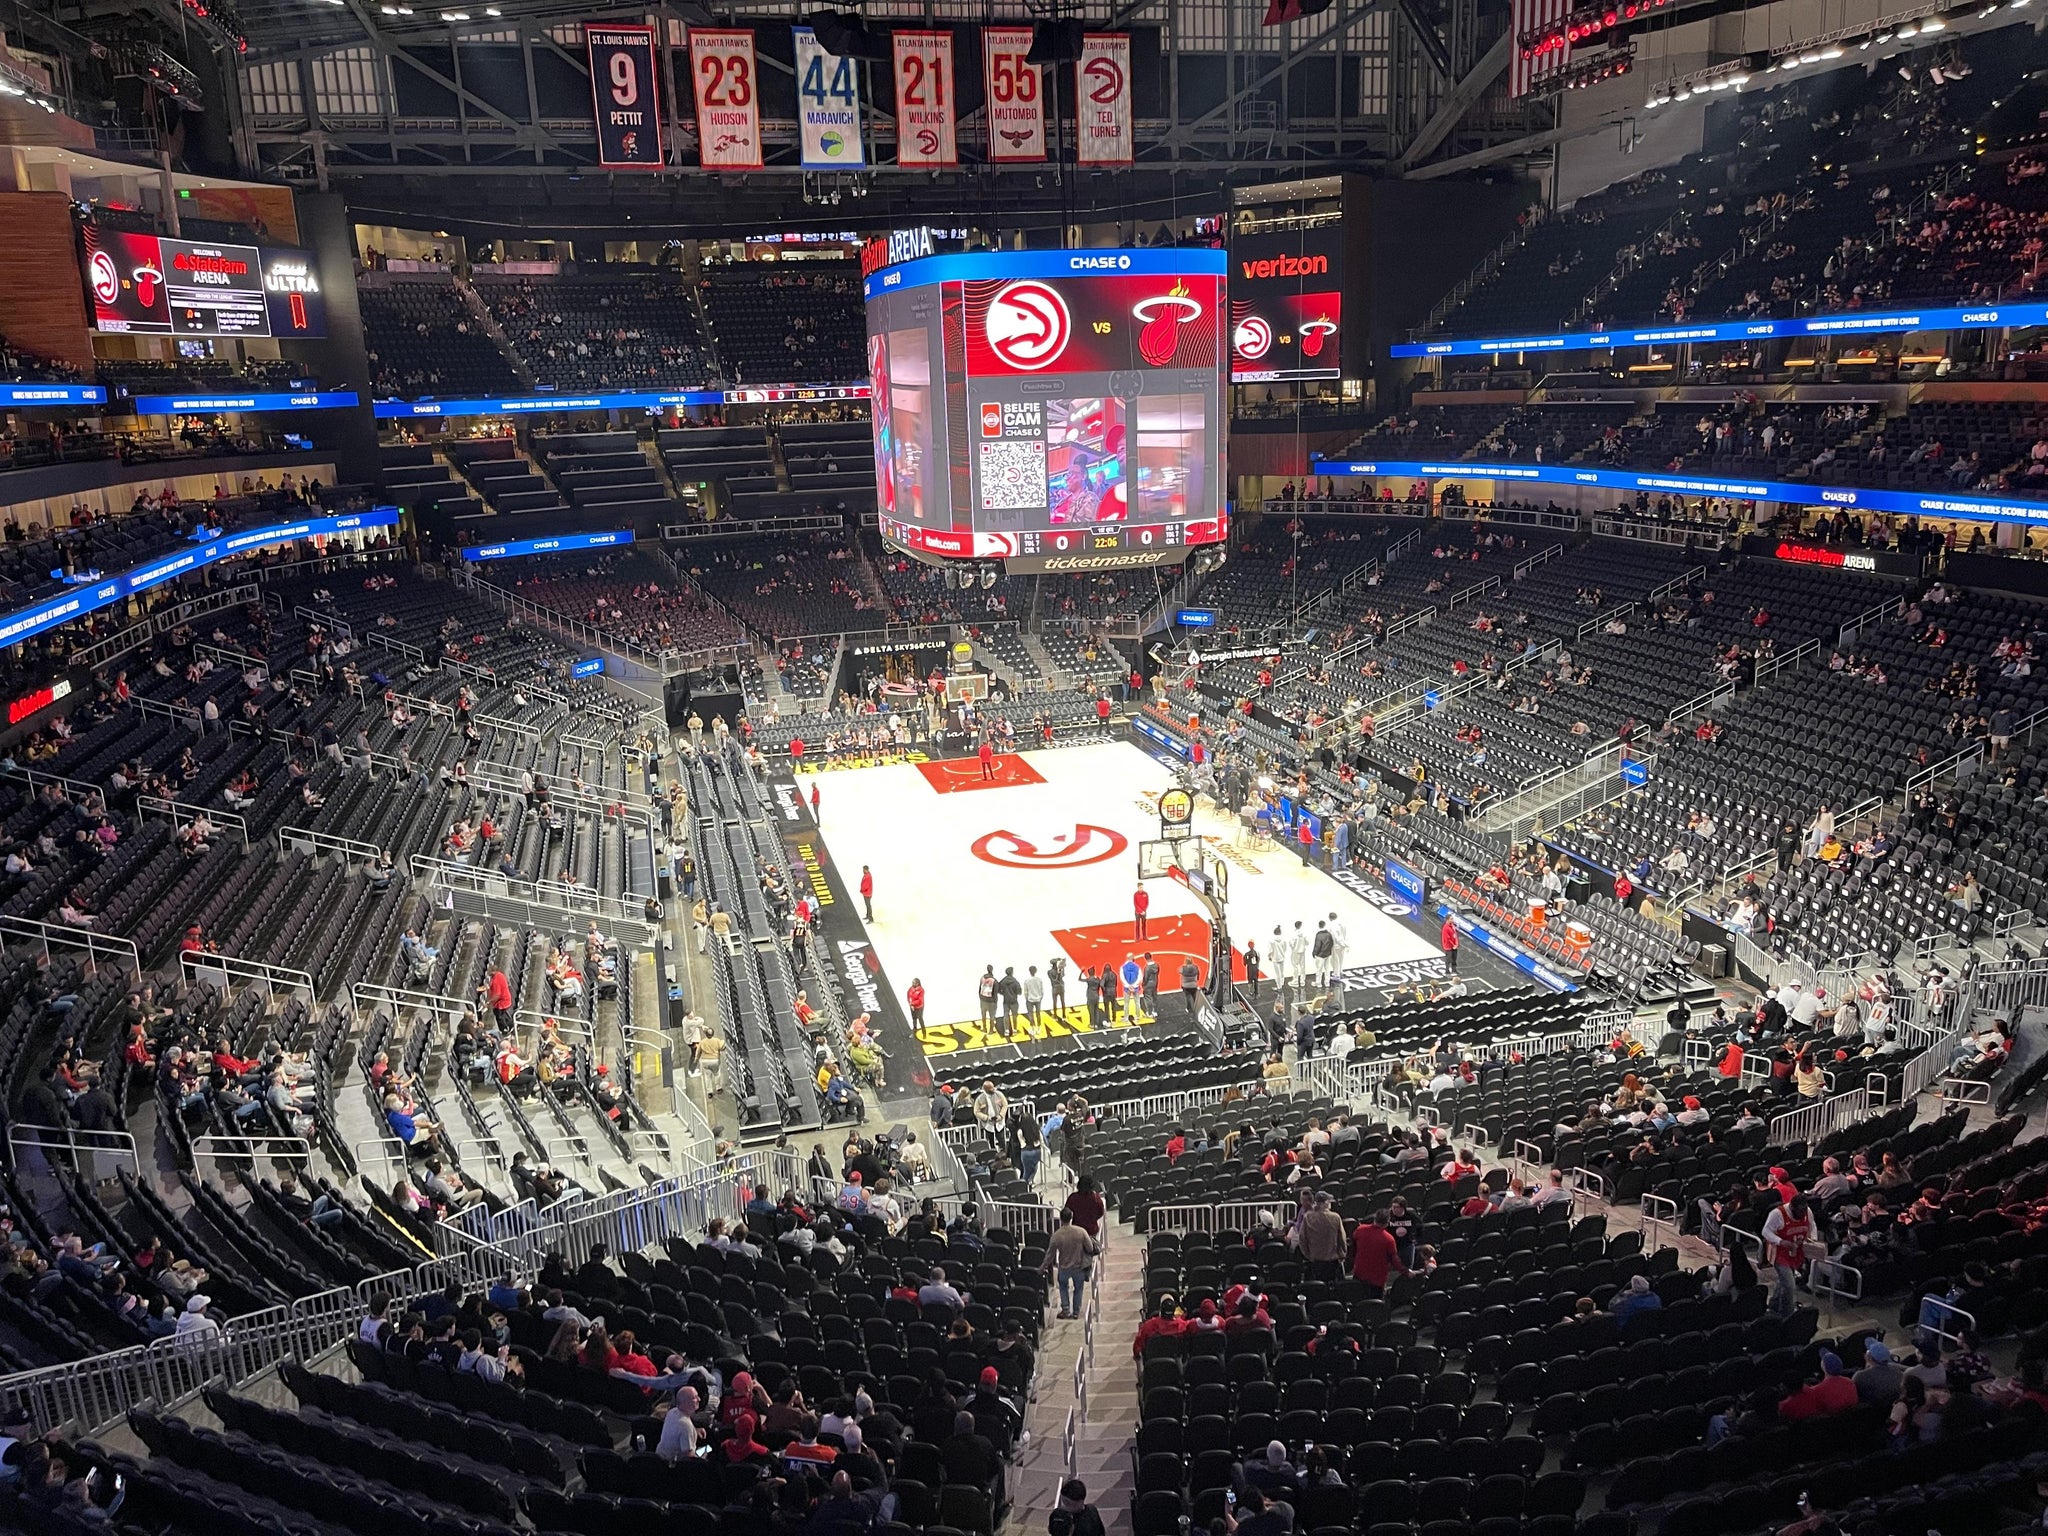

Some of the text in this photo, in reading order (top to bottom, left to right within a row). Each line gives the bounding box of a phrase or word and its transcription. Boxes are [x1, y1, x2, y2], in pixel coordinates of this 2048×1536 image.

[592, 35, 649, 46] ST. LOUIS HAWKS
[695, 38, 749, 48] ATLANTA HAWKS
[800, 37, 818, 45] ATLA
[897, 39, 948, 48] ATLANTA HAWKS
[1014, 36, 1033, 45] HAWK
[1083, 42, 1126, 50] TLANTA HAWKS
[609, 52, 637, 107] 9
[701, 55, 750, 107] 23
[802, 55, 855, 107] 44
[903, 55, 944, 106] 21
[993, 53, 1036, 103] 55
[610, 111, 643, 126] PETTIT
[710, 112, 748, 126] HUDSON
[807, 111, 854, 125] MARAVICH
[908, 111, 945, 124] WILKINS
[994, 108, 1037, 120] MUTOMBO
[1097, 111, 1113, 123] TED
[1089, 125, 1122, 138] TURNER
[888, 225, 932, 265] ARENA
[193, 249, 215, 257] WELCOME
[1070, 257, 1117, 269] CHASE
[1242, 253, 1328, 279] verizon
[193, 271, 231, 285] ARENA
[265, 275, 319, 293] ULTRA
[1844, 320, 1863, 329] SCORE
[1881, 317, 1899, 327] WITH
[1899, 316, 1920, 326] CHASE
[1962, 313, 1989, 323] CHASE
[1747, 327, 1768, 335] CHASE
[291, 397, 312, 405] CHASE
[1003, 402, 1041, 413] SELFIE
[1003, 412, 1041, 426] CAM
[1005, 428, 1033, 437] CHASE
[1822, 491, 1848, 503] CHASE
[1920, 499, 1944, 511] CHASE
[1944, 502, 2001, 516] CARDHOLDERS
[2001, 506, 2027, 517] SCORE
[589, 536, 610, 544] CHASE
[926, 536, 961, 551] Hawks.com
[1056, 535, 1069, 550] 0
[1094, 537, 1118, 549] 22:06
[1141, 531, 1152, 545] 0
[480, 547, 500, 556] CHASE
[1044, 551, 1167, 570] ticketmaster
[1843, 555, 1876, 570] ARENA
[863, 645, 893, 655] DELTA
[926, 641, 947, 650] CLUB
[1200, 646, 1280, 662] Georgia Natural Gas
[797, 843, 835, 906] TRUE TO ATLANTA
[1390, 869, 1412, 890] CHASE
[1332, 870, 1397, 906] CHASE
[1342, 958, 1446, 977] HEALTHCAR
[843, 951, 882, 1013] Georgia Power
[916, 998, 1156, 1055] HAWKS
[840, 1194, 859, 1210] 29
